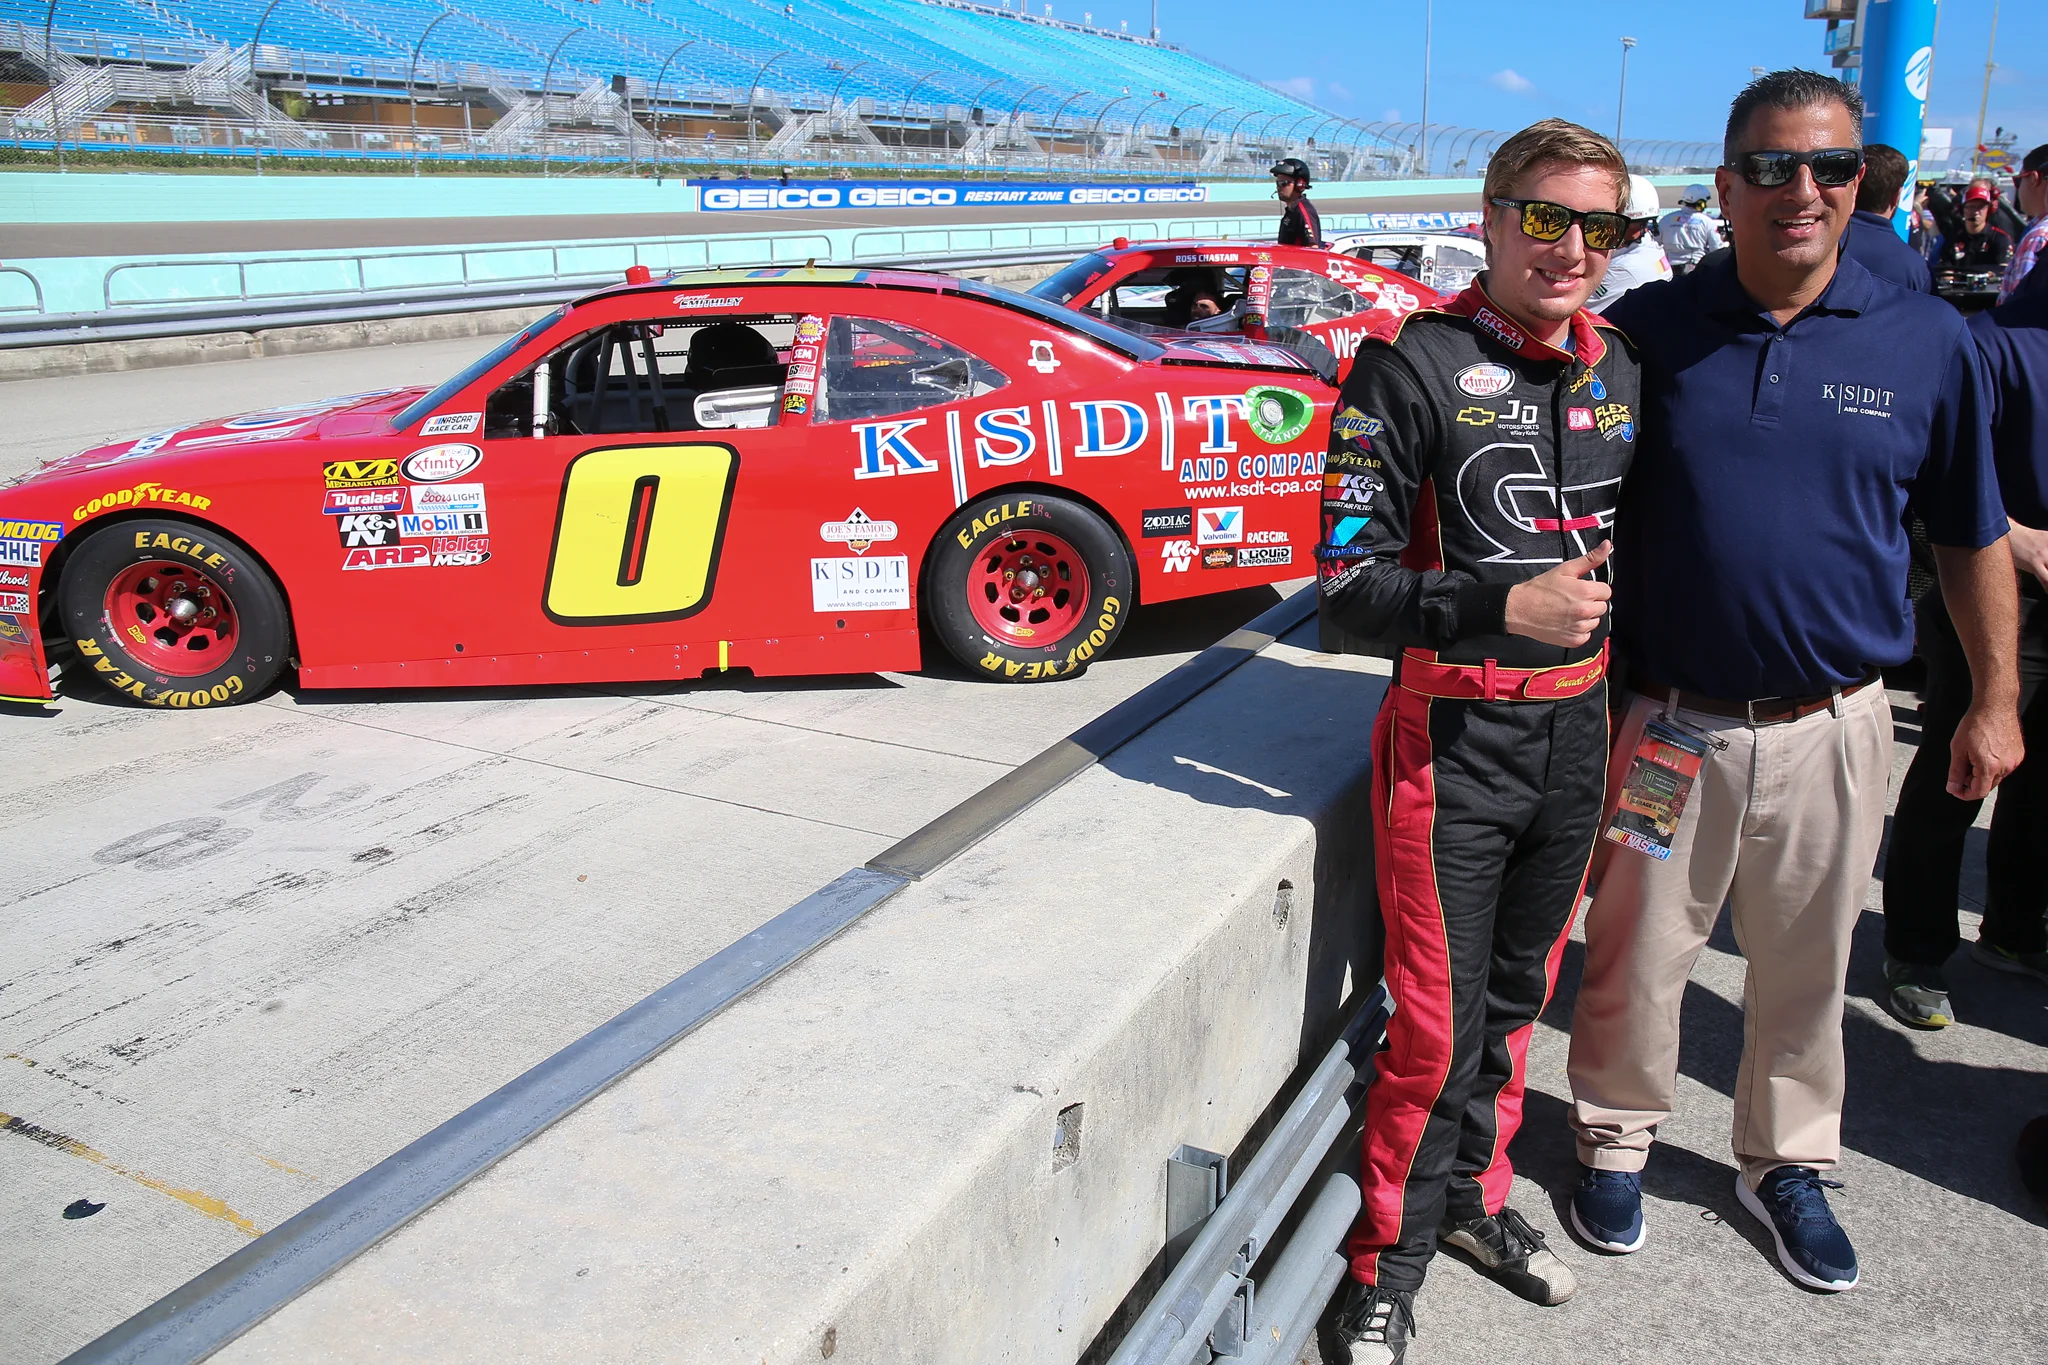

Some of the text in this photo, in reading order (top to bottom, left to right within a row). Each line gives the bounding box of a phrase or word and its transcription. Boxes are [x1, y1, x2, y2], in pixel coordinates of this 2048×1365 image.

[704, 187, 1205, 209] GEICO GEICO RESTART ZONE GEICO GEICO
[1175, 253, 1239, 263] ROSS CHASTAIN
[1475, 318, 1520, 349] RACING GEAR
[794, 348, 813, 360] SEM
[1463, 376, 1502, 391] xfinity
[1248, 385, 1303, 405] AMERICAN
[1568, 410, 1592, 427] SEM
[1594, 403, 1630, 420] FLEX
[1859, 408, 1891, 418] COMPANY
[439, 415, 473, 425] NASCAR
[1597, 414, 1631, 434] TAPE
[428, 425, 450, 433] RACE
[1252, 421, 1308, 443] ETHANOL
[414, 456, 465, 472] xfinity
[1179, 456, 1229, 482] AND
[326, 475, 399, 488] MECHANIX WEAR
[331, 490, 399, 506] Duralast
[420, 490, 480, 503] Coors LIGHT
[403, 514, 458, 533] Mobil
[826, 524, 893, 534] JOE'S FAMOUS
[956, 500, 1032, 550] EAGLE
[1143, 514, 1190, 528] ZODIAC
[541, 441, 741, 627] 0
[1202, 533, 1238, 541] Valvoline
[135, 531, 227, 569] EAGLE
[432, 537, 490, 555] Holley
[346, 546, 428, 567] ARP
[432, 554, 483, 567] MSD
[1239, 556, 1290, 566] PERFORMANCE
[1339, 571, 1350, 581] FOR
[1349, 560, 1376, 573] ADVANCED
[826, 600, 897, 610] www.ksdt-cpa.com
[1631, 797, 1653, 810] GARAGE
[1657, 804, 1669, 816] PITS
[1622, 826, 1648, 841] NOVEMBER
[1624, 834, 1673, 860] NASCAR
